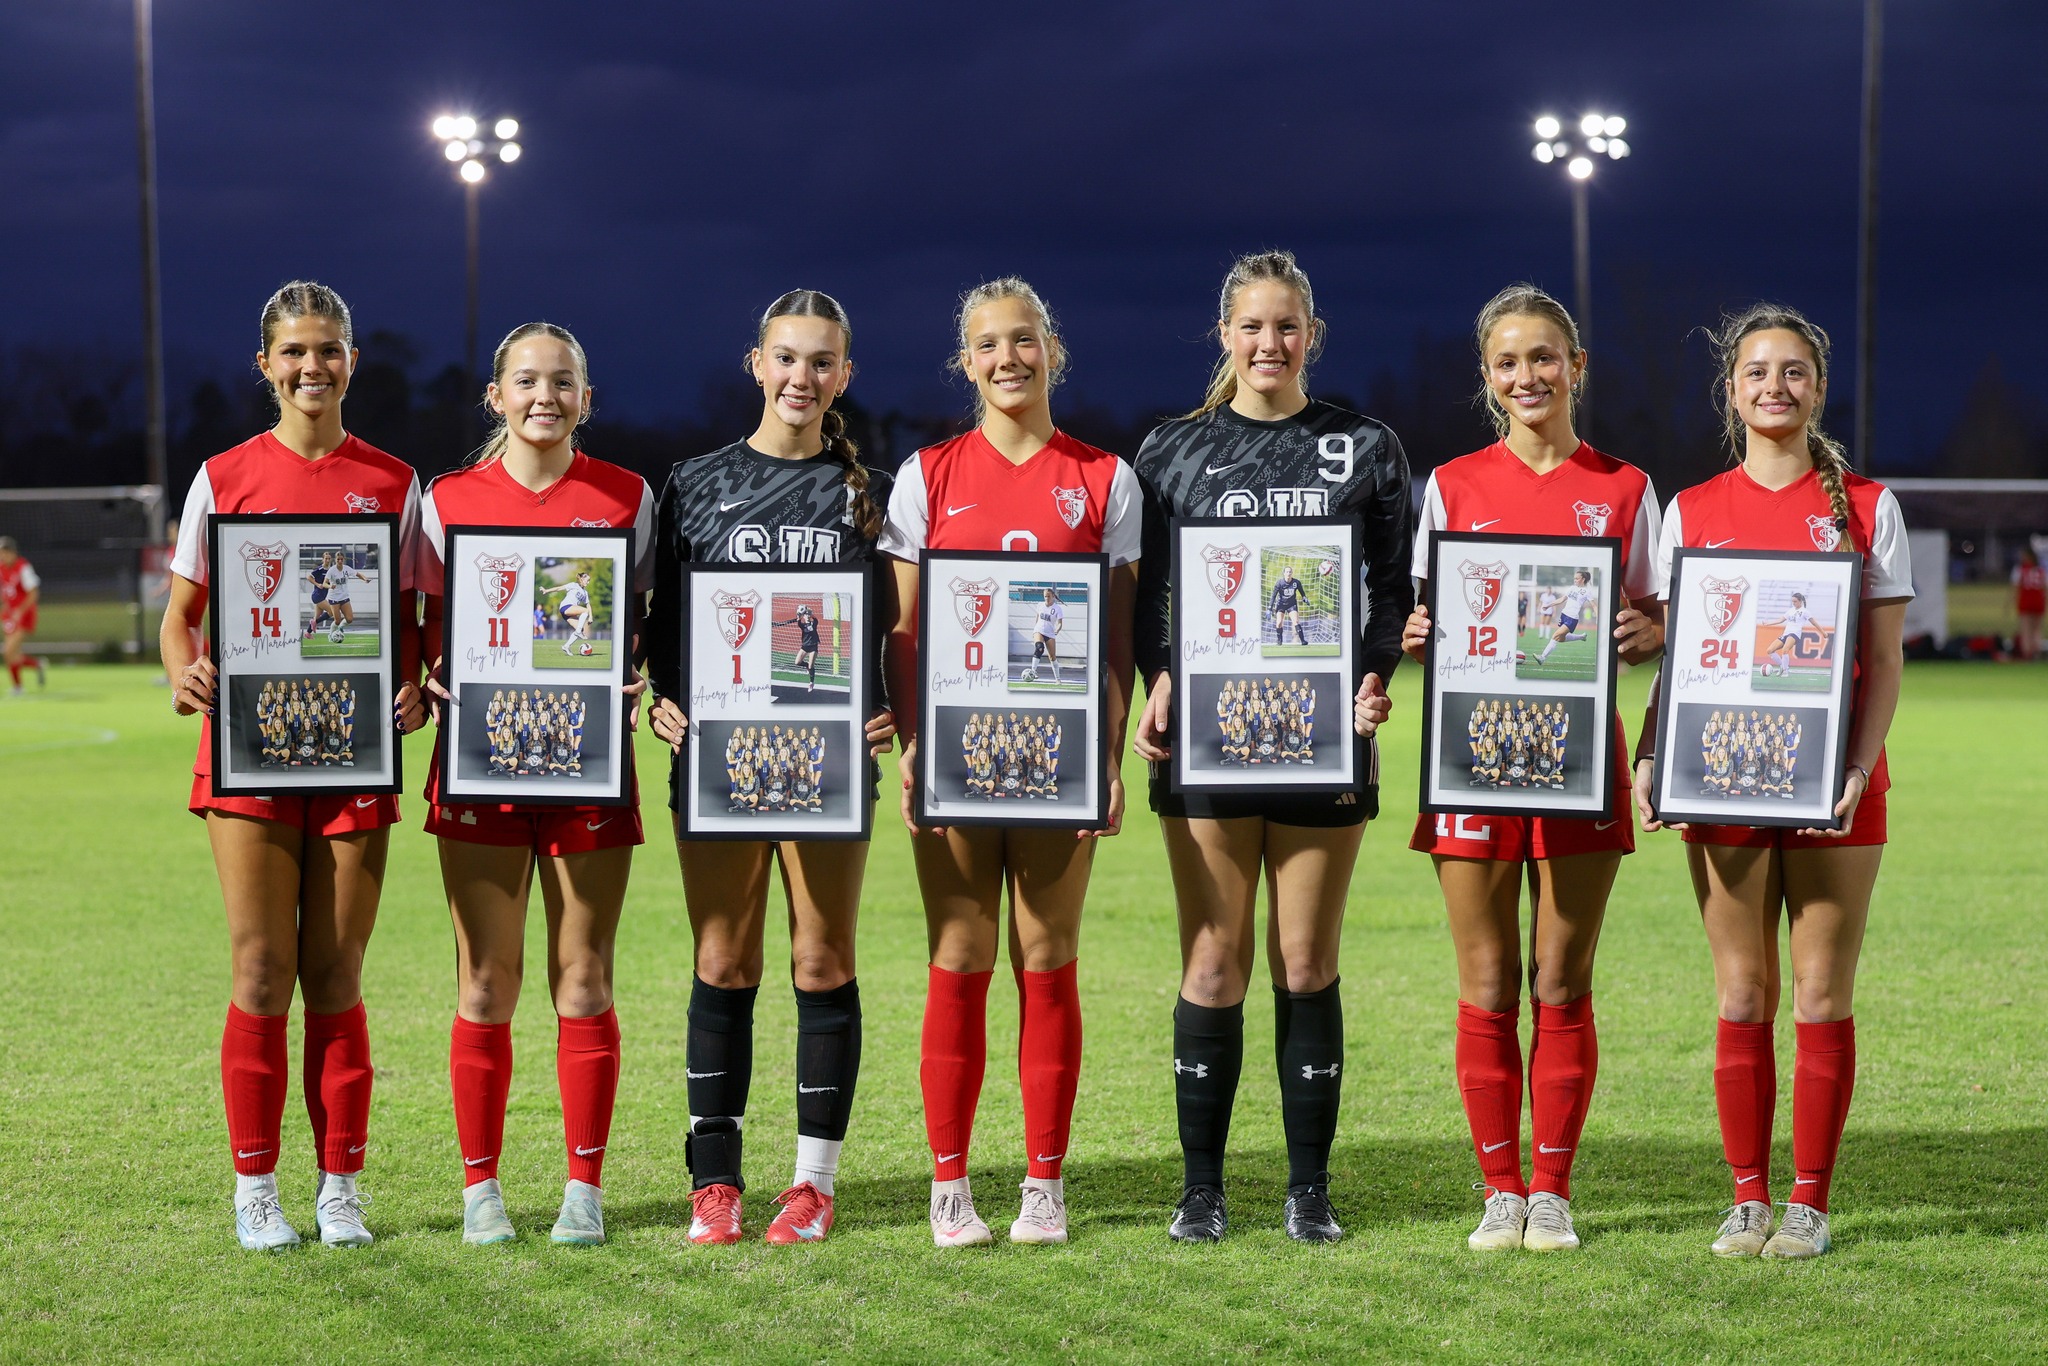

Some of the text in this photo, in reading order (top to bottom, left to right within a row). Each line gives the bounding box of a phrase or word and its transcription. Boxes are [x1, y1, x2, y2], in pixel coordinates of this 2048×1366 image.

[1317, 433, 1354, 483] 9
[250, 607, 282, 638] 14
[488, 617, 510, 647] 11
[1218, 608, 1236, 638] 9
[219, 641, 250, 662] Wren
[964, 641, 984, 671] 0
[1184, 640, 1211, 662] Clare
[1467, 625, 1498, 657] 12
[1699, 638, 1739, 669] 24
[466, 646, 519, 672] Ivy May
[731, 654, 743, 684] 1
[1438, 654, 1477, 679] Amelia
[931, 665, 1006, 693] Grace Mathis
[1677, 665, 1749, 690] Claire Canova
[691, 685, 729, 709] Avery
